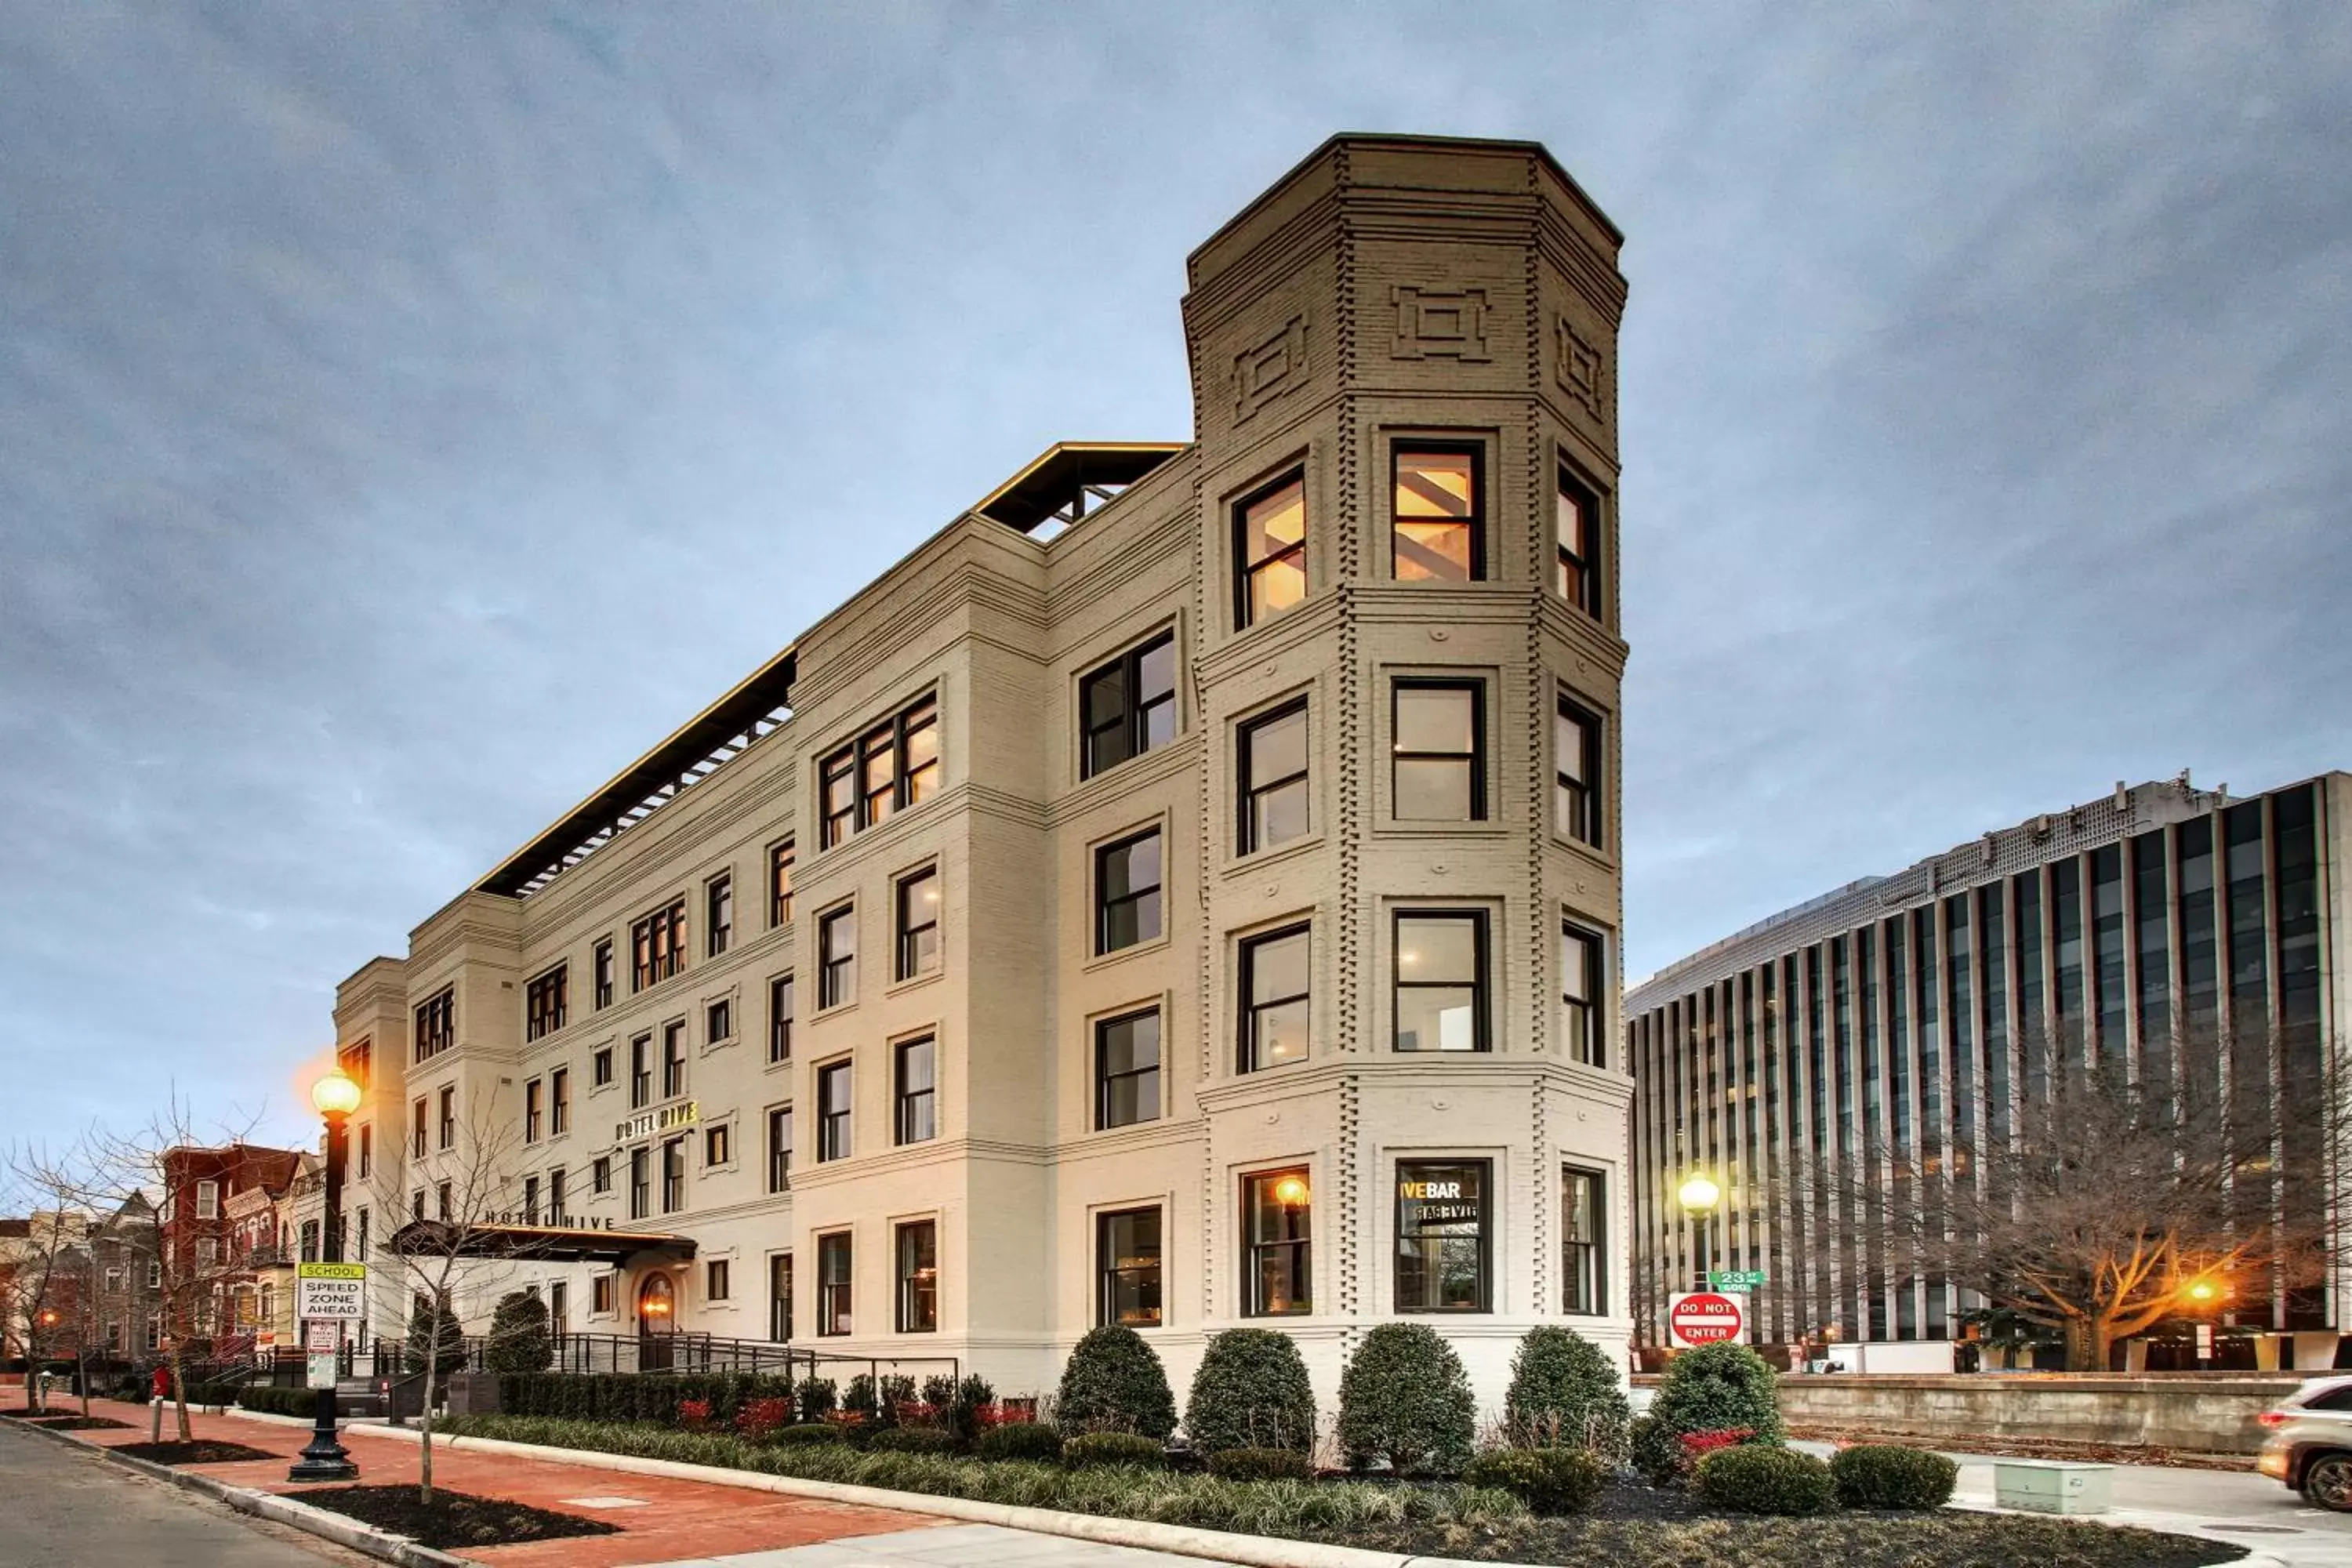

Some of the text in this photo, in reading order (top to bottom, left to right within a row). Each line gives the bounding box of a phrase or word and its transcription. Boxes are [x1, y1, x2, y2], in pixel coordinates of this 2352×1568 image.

[615, 1101, 698, 1142] HOTEL HIVE
[564, 1216, 614, 1230] HIVE
[306, 1266, 358, 1276] SCHOOL
[1721, 1272, 1744, 1283] 23
[307, 1282, 358, 1293] SPEED
[309, 1294, 355, 1303] ZONE
[307, 1305, 358, 1314] AHEAD
[1680, 1304, 1731, 1313] DO NOT
[1686, 1327, 1727, 1338] ENTER
